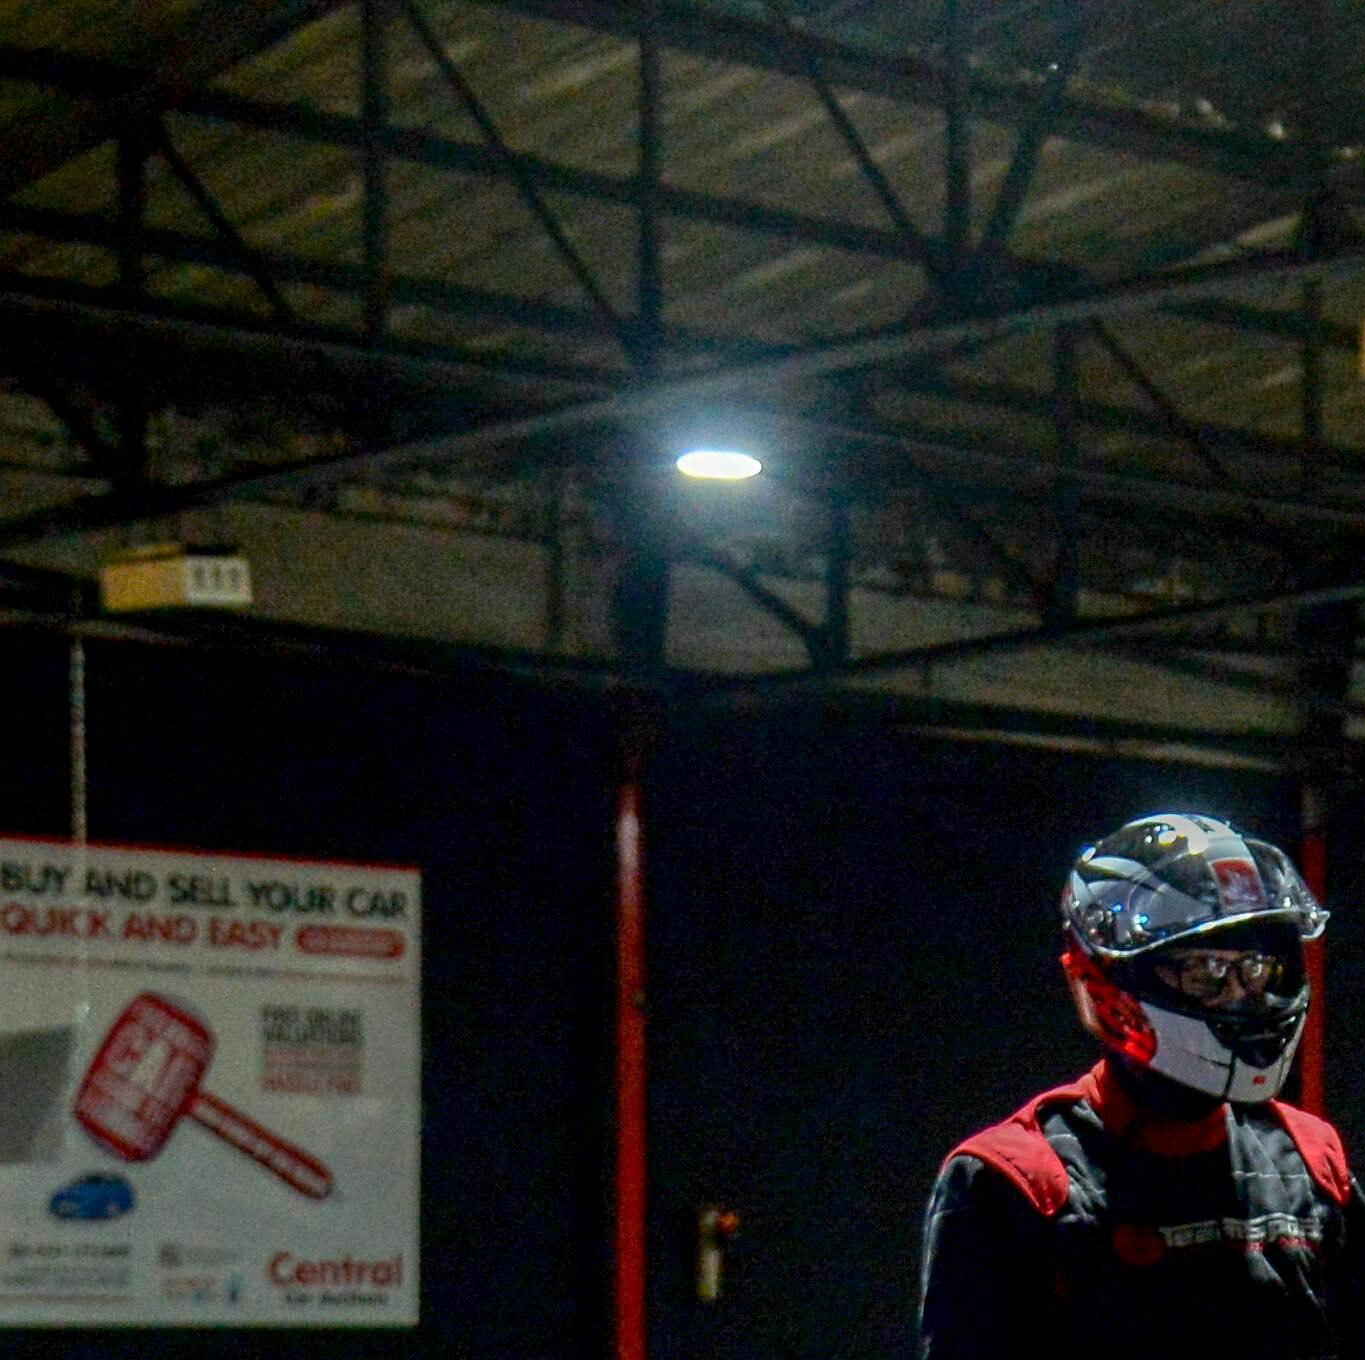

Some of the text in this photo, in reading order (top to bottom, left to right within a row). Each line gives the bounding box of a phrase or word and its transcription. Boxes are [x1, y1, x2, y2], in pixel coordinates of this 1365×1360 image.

[1, 862, 405, 919] BUY AND SELL YOUR CAR
[2, 902, 110, 937] QUICK
[121, 912, 197, 943] AND
[208, 917, 284, 951] EASY
[268, 1251, 401, 1287] Central
